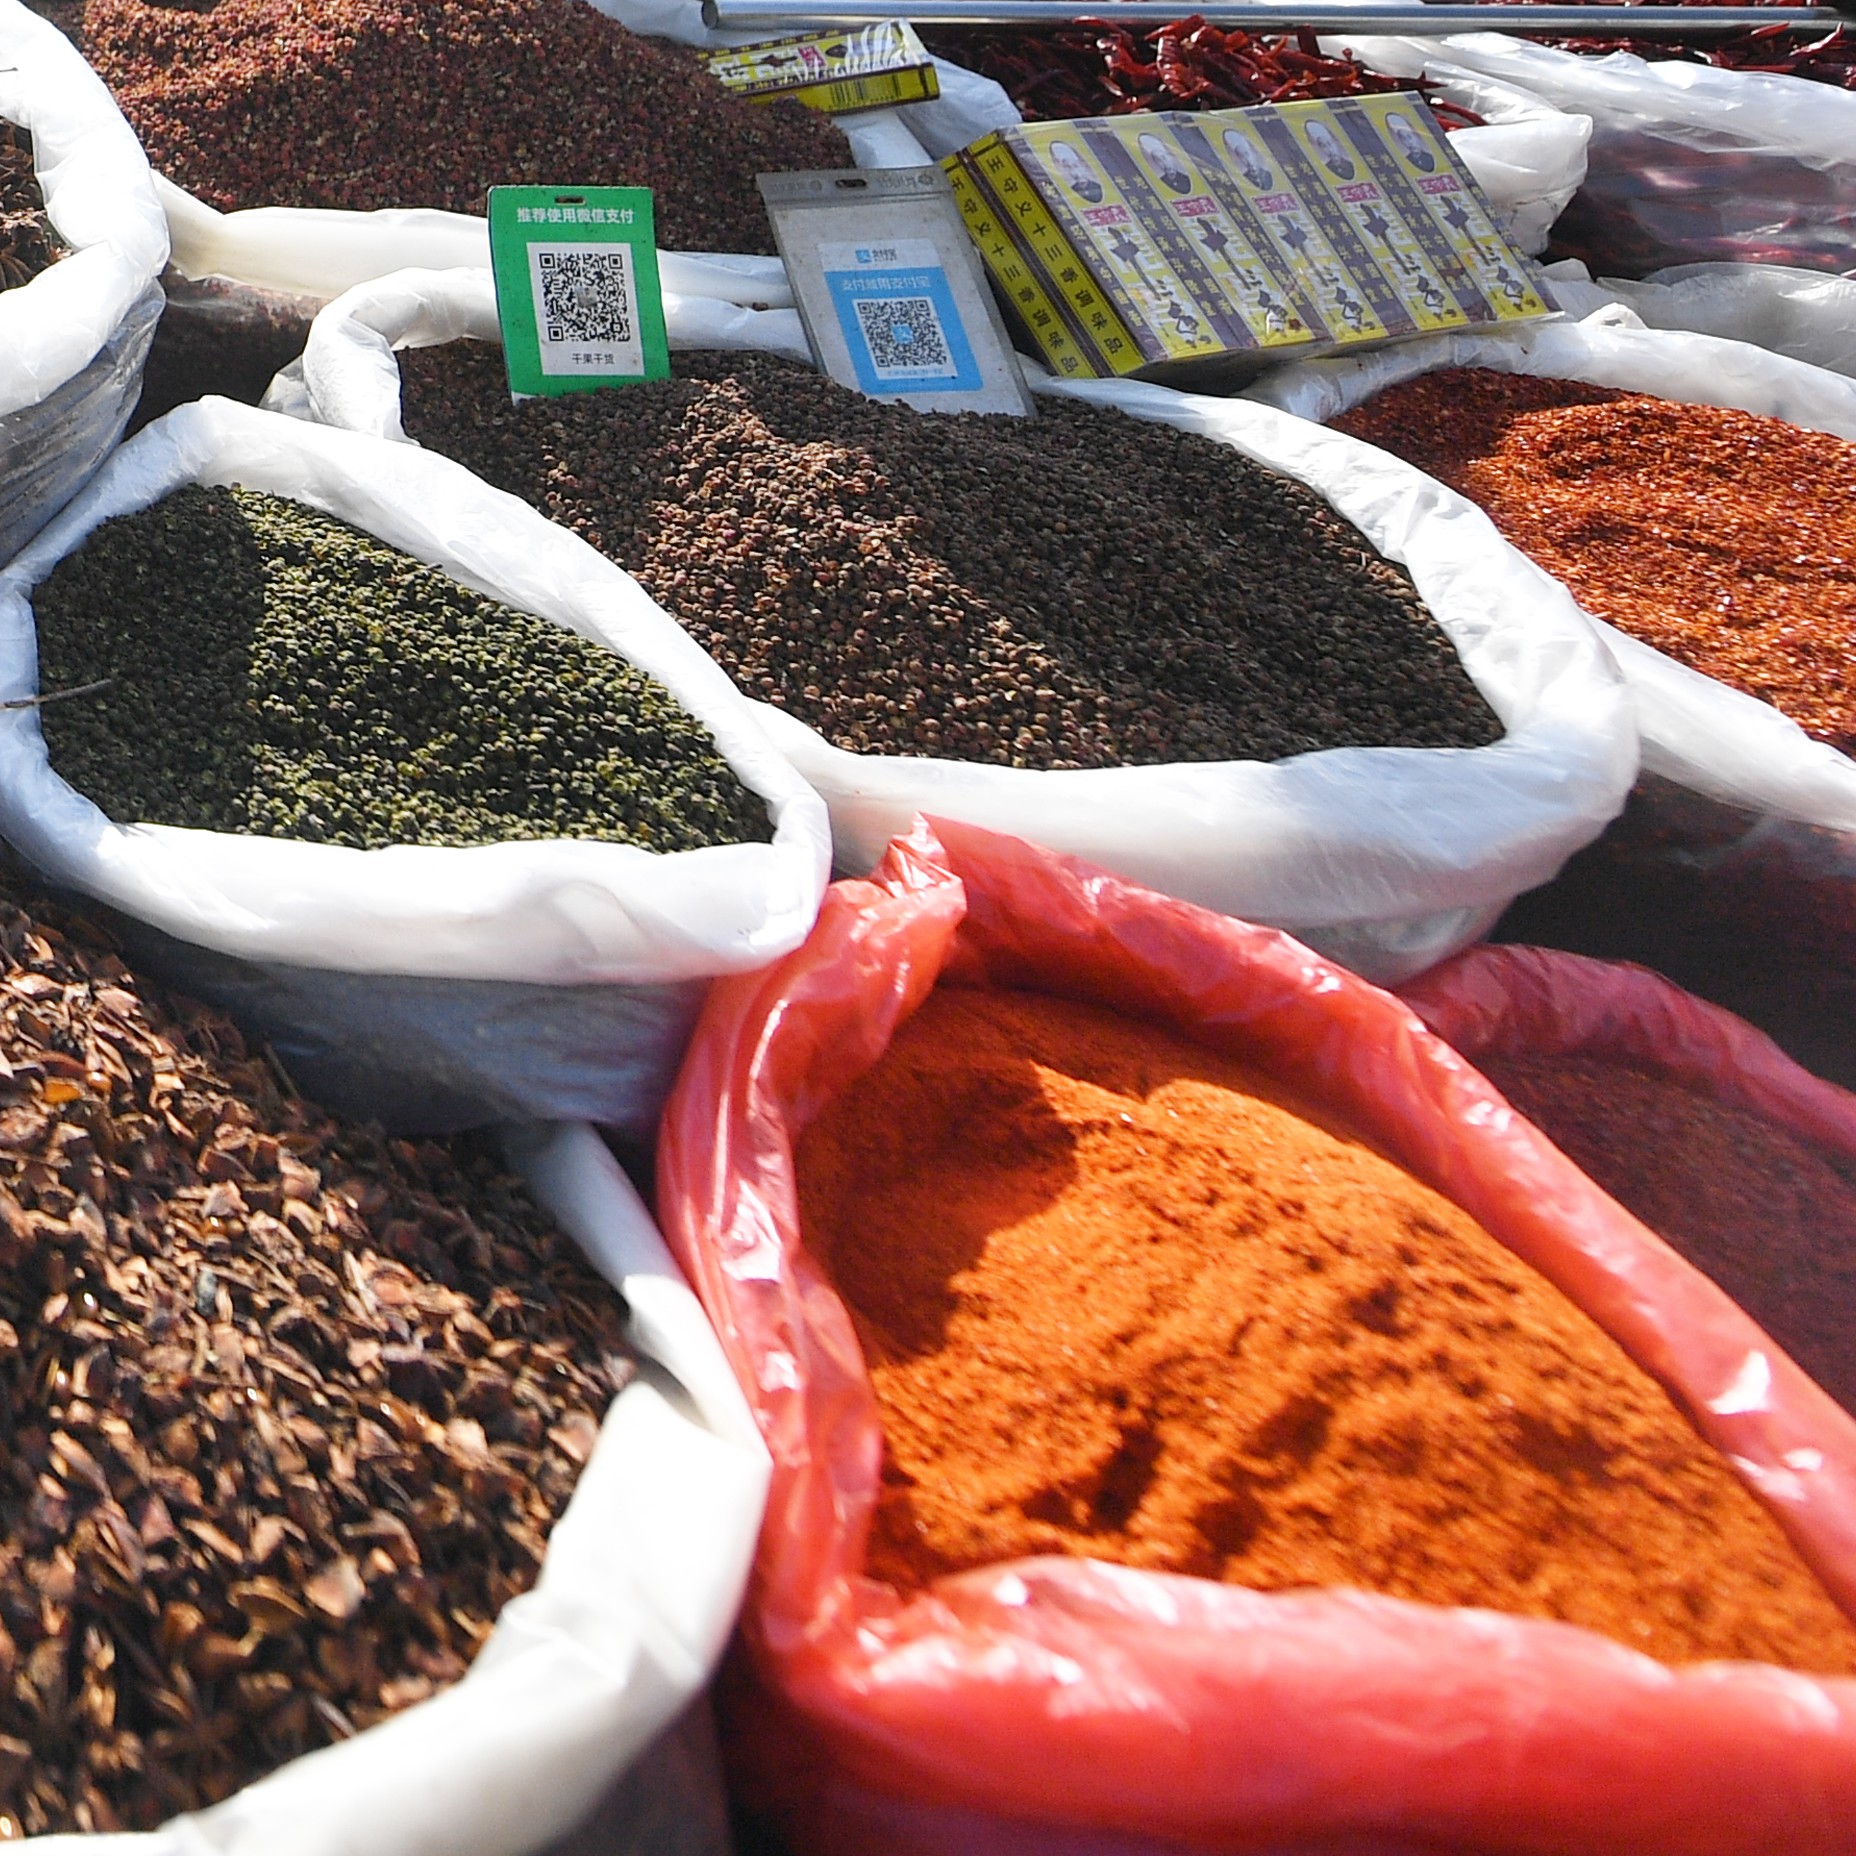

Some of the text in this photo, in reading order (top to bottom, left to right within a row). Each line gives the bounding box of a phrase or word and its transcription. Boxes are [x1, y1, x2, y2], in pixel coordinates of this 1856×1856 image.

[516, 208, 634, 224] 推荐使用微信支付
[985, 155, 1124, 355] 王守义十三香调味品
[949, 176, 1080, 373] 王守义十三香调味品
[571, 352, 615, 366] 干果干货
